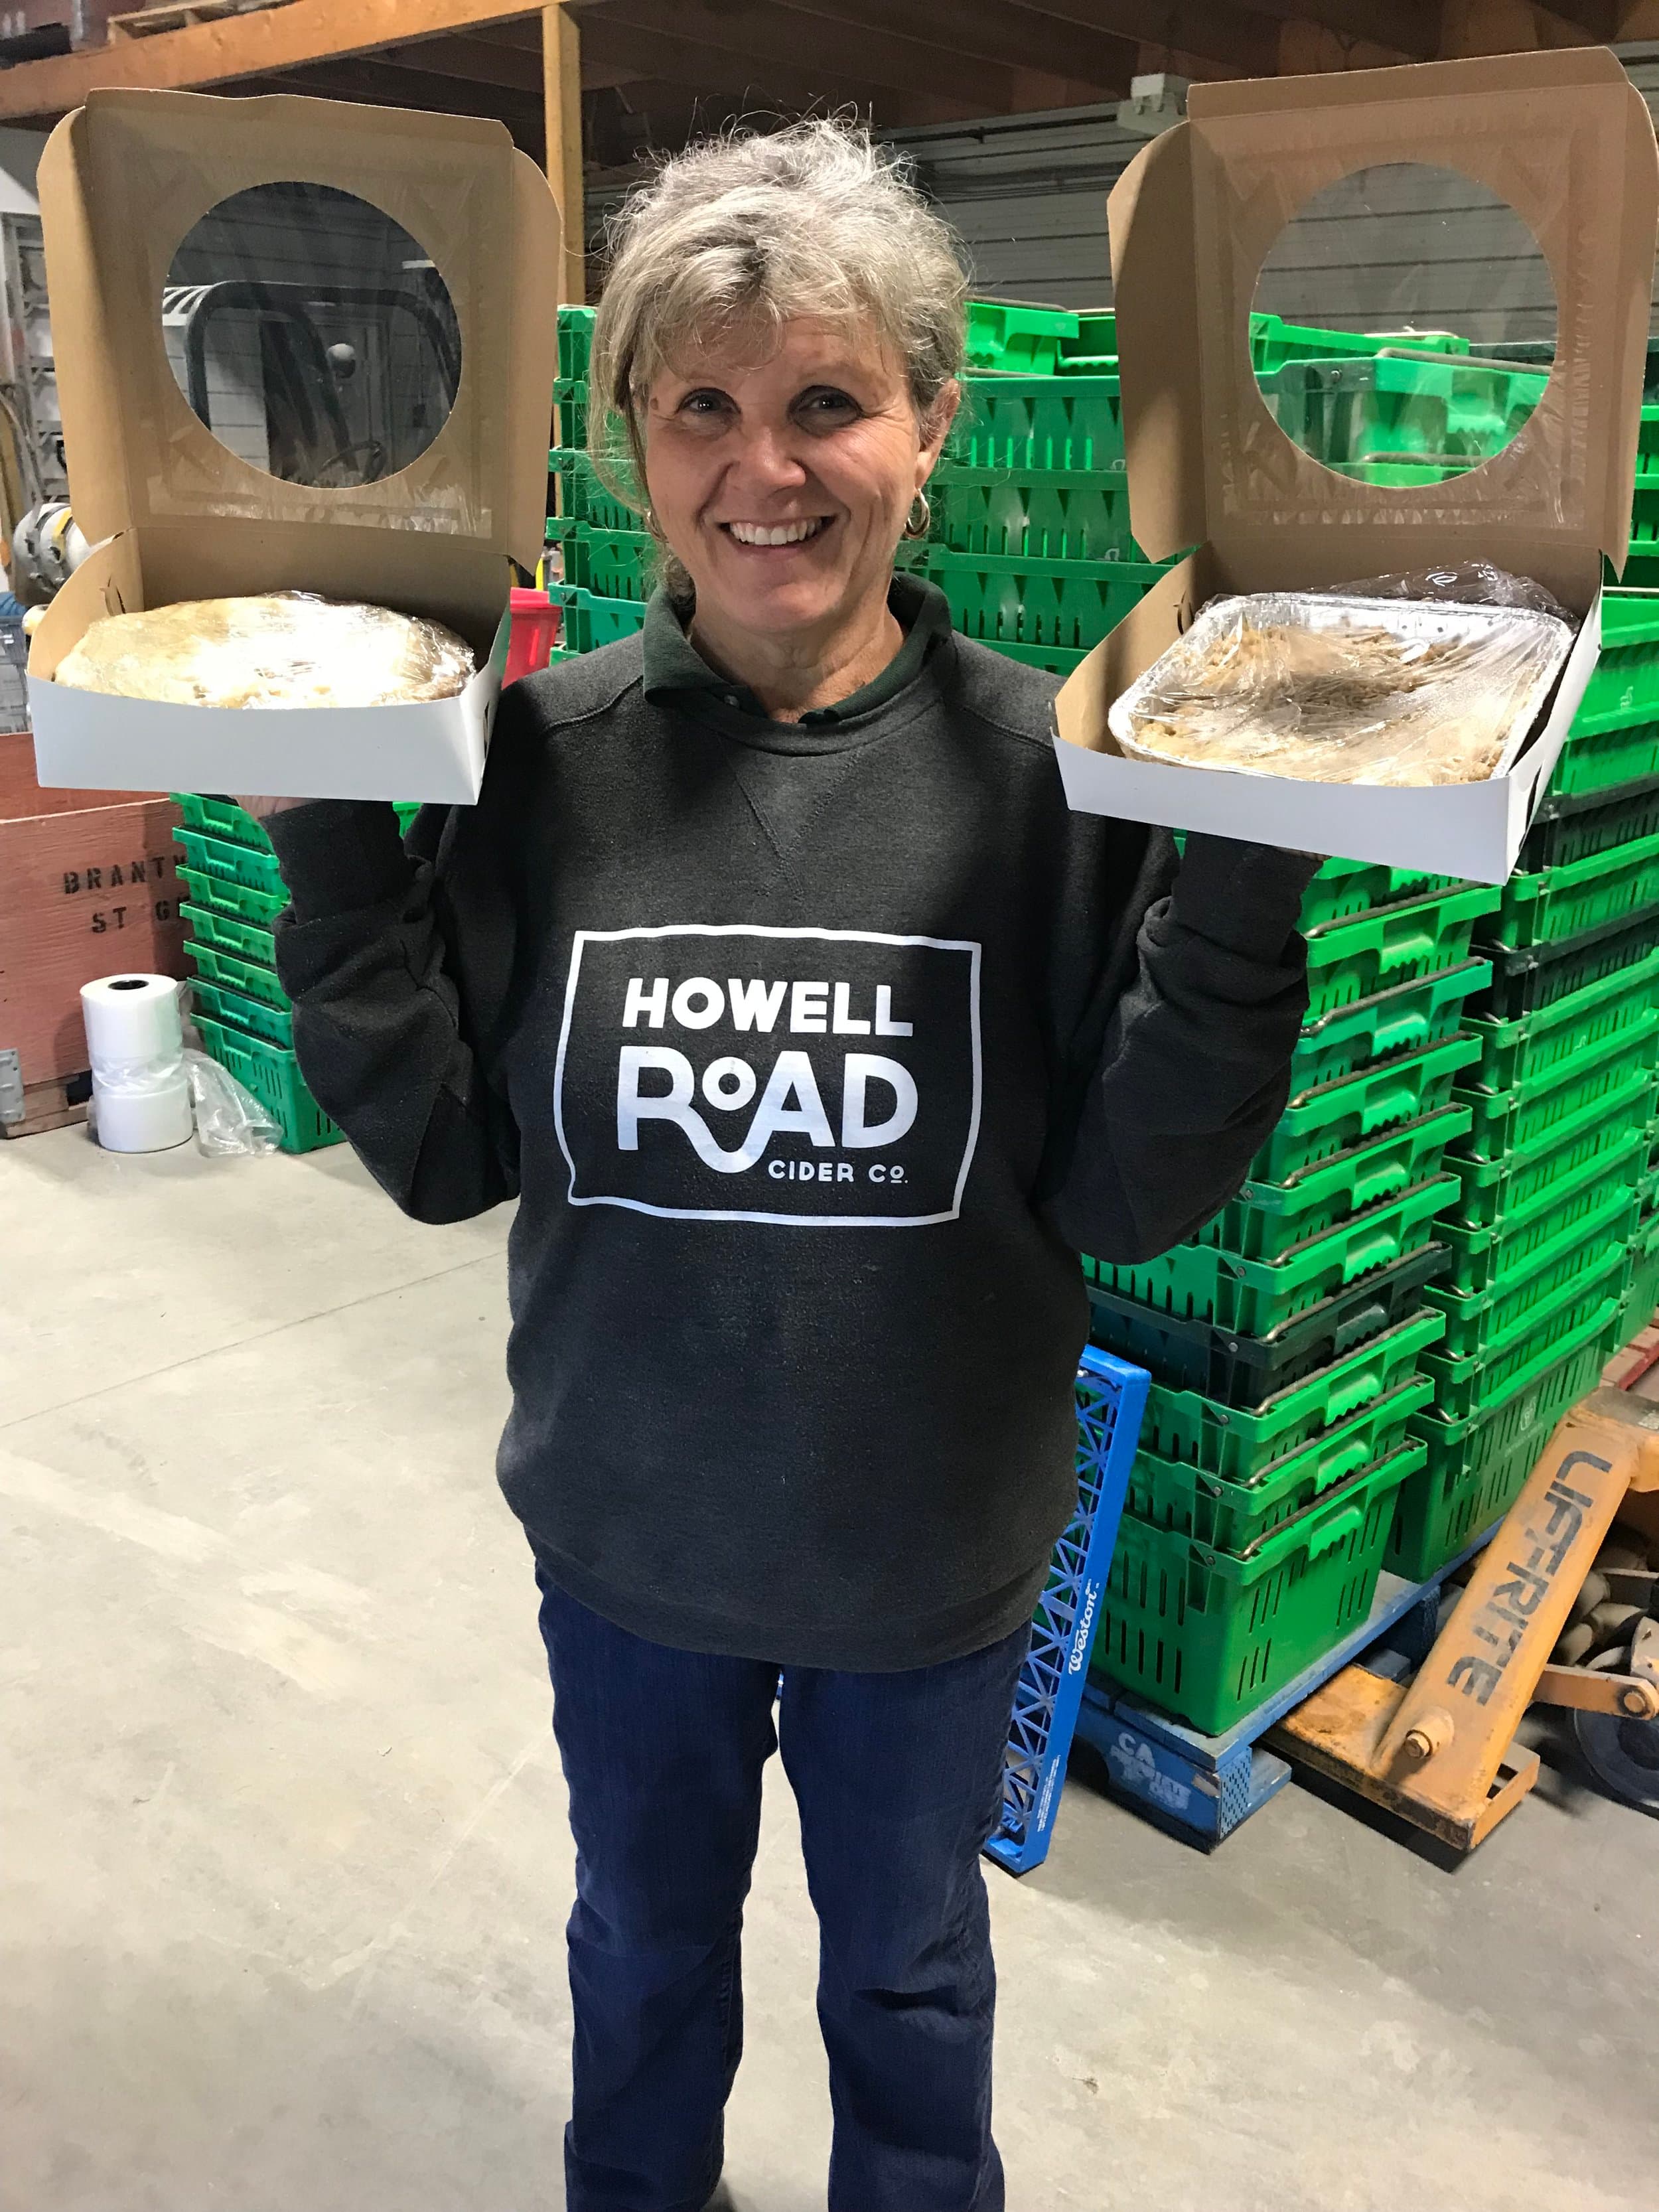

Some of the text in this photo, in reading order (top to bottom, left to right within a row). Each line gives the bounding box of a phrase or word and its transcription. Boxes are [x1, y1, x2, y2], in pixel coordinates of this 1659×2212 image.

[92, 907, 127, 933] ST
[622, 977, 913, 1037] HOWELL
[616, 1045, 918, 1173] ROAD
[768, 1159, 855, 1183] CIDER
